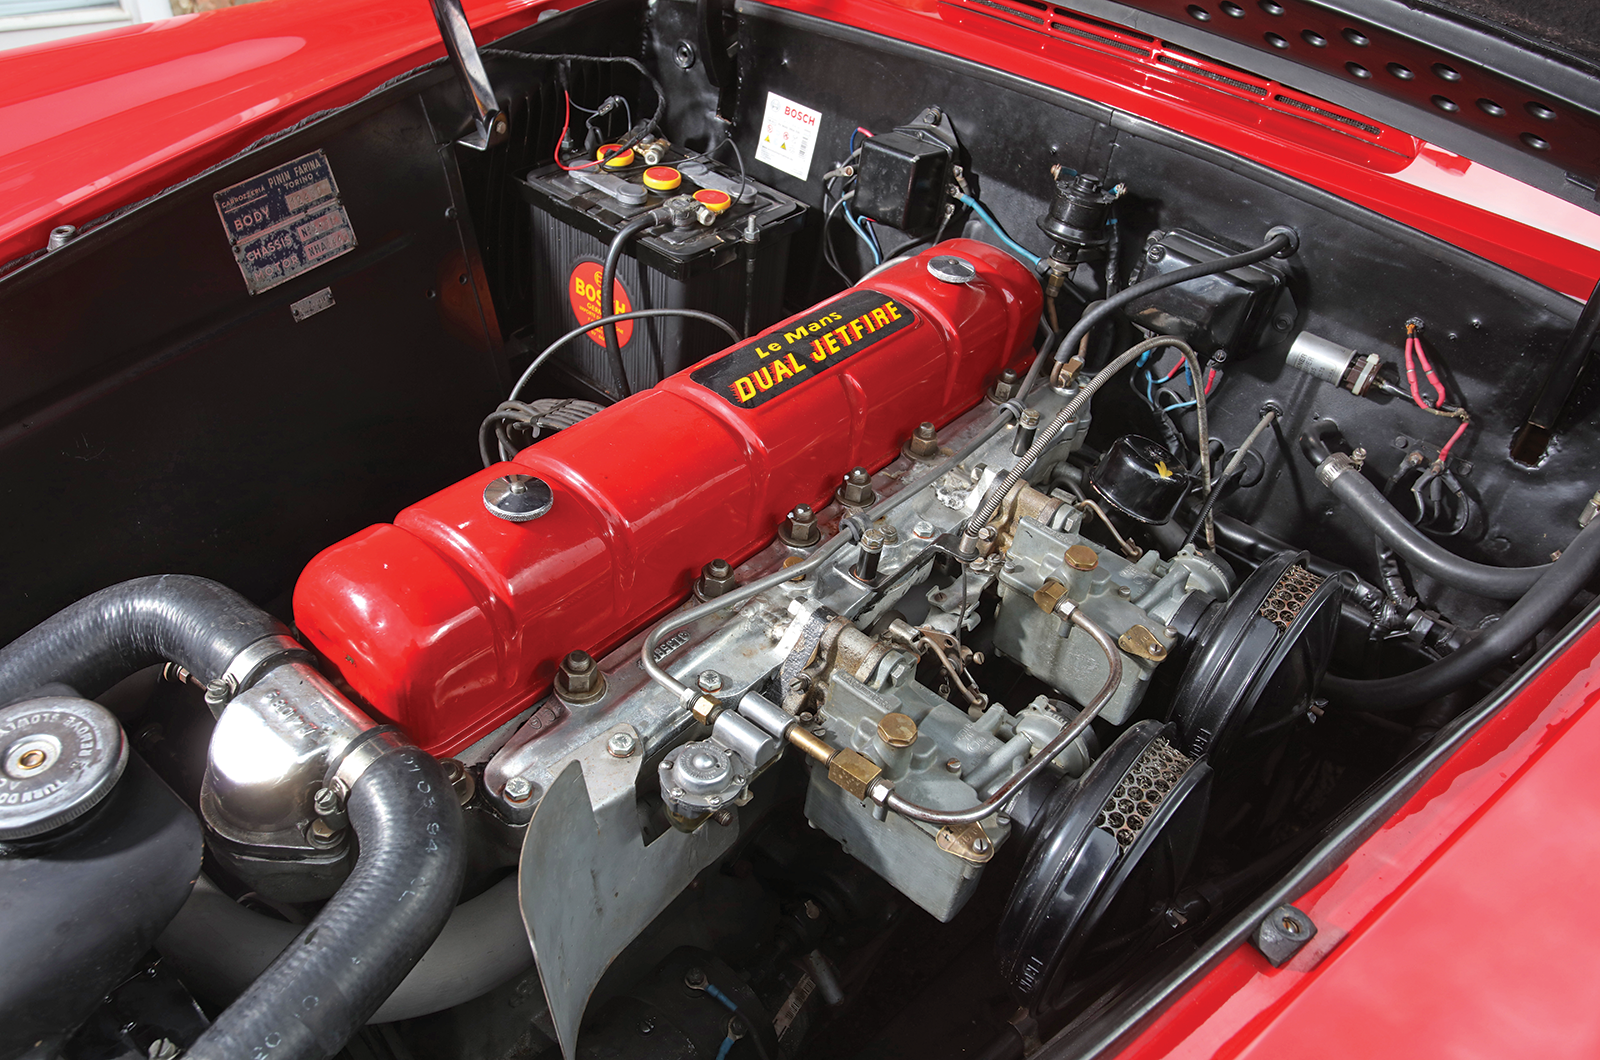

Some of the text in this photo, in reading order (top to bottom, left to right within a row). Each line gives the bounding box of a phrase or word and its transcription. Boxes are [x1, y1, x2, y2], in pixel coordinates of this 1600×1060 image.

[784, 105, 816, 126] BOSCH
[221, 187, 266, 208] CARROZZERIA
[268, 171, 291, 188] PININ
[294, 158, 321, 177] FARINA
[284, 173, 313, 190] TORINO
[234, 206, 270, 231] BODY
[246, 235, 292, 262] CHASSIS
[254, 255, 299, 281] MOTOR
[575, 276, 626, 316] BOSH
[755, 311, 843, 360] Le Mans
[729, 301, 902, 404] DUAL JETFIRE
[62, 716, 94, 757] REMOVE
[21, 779, 67, 802] TURN
